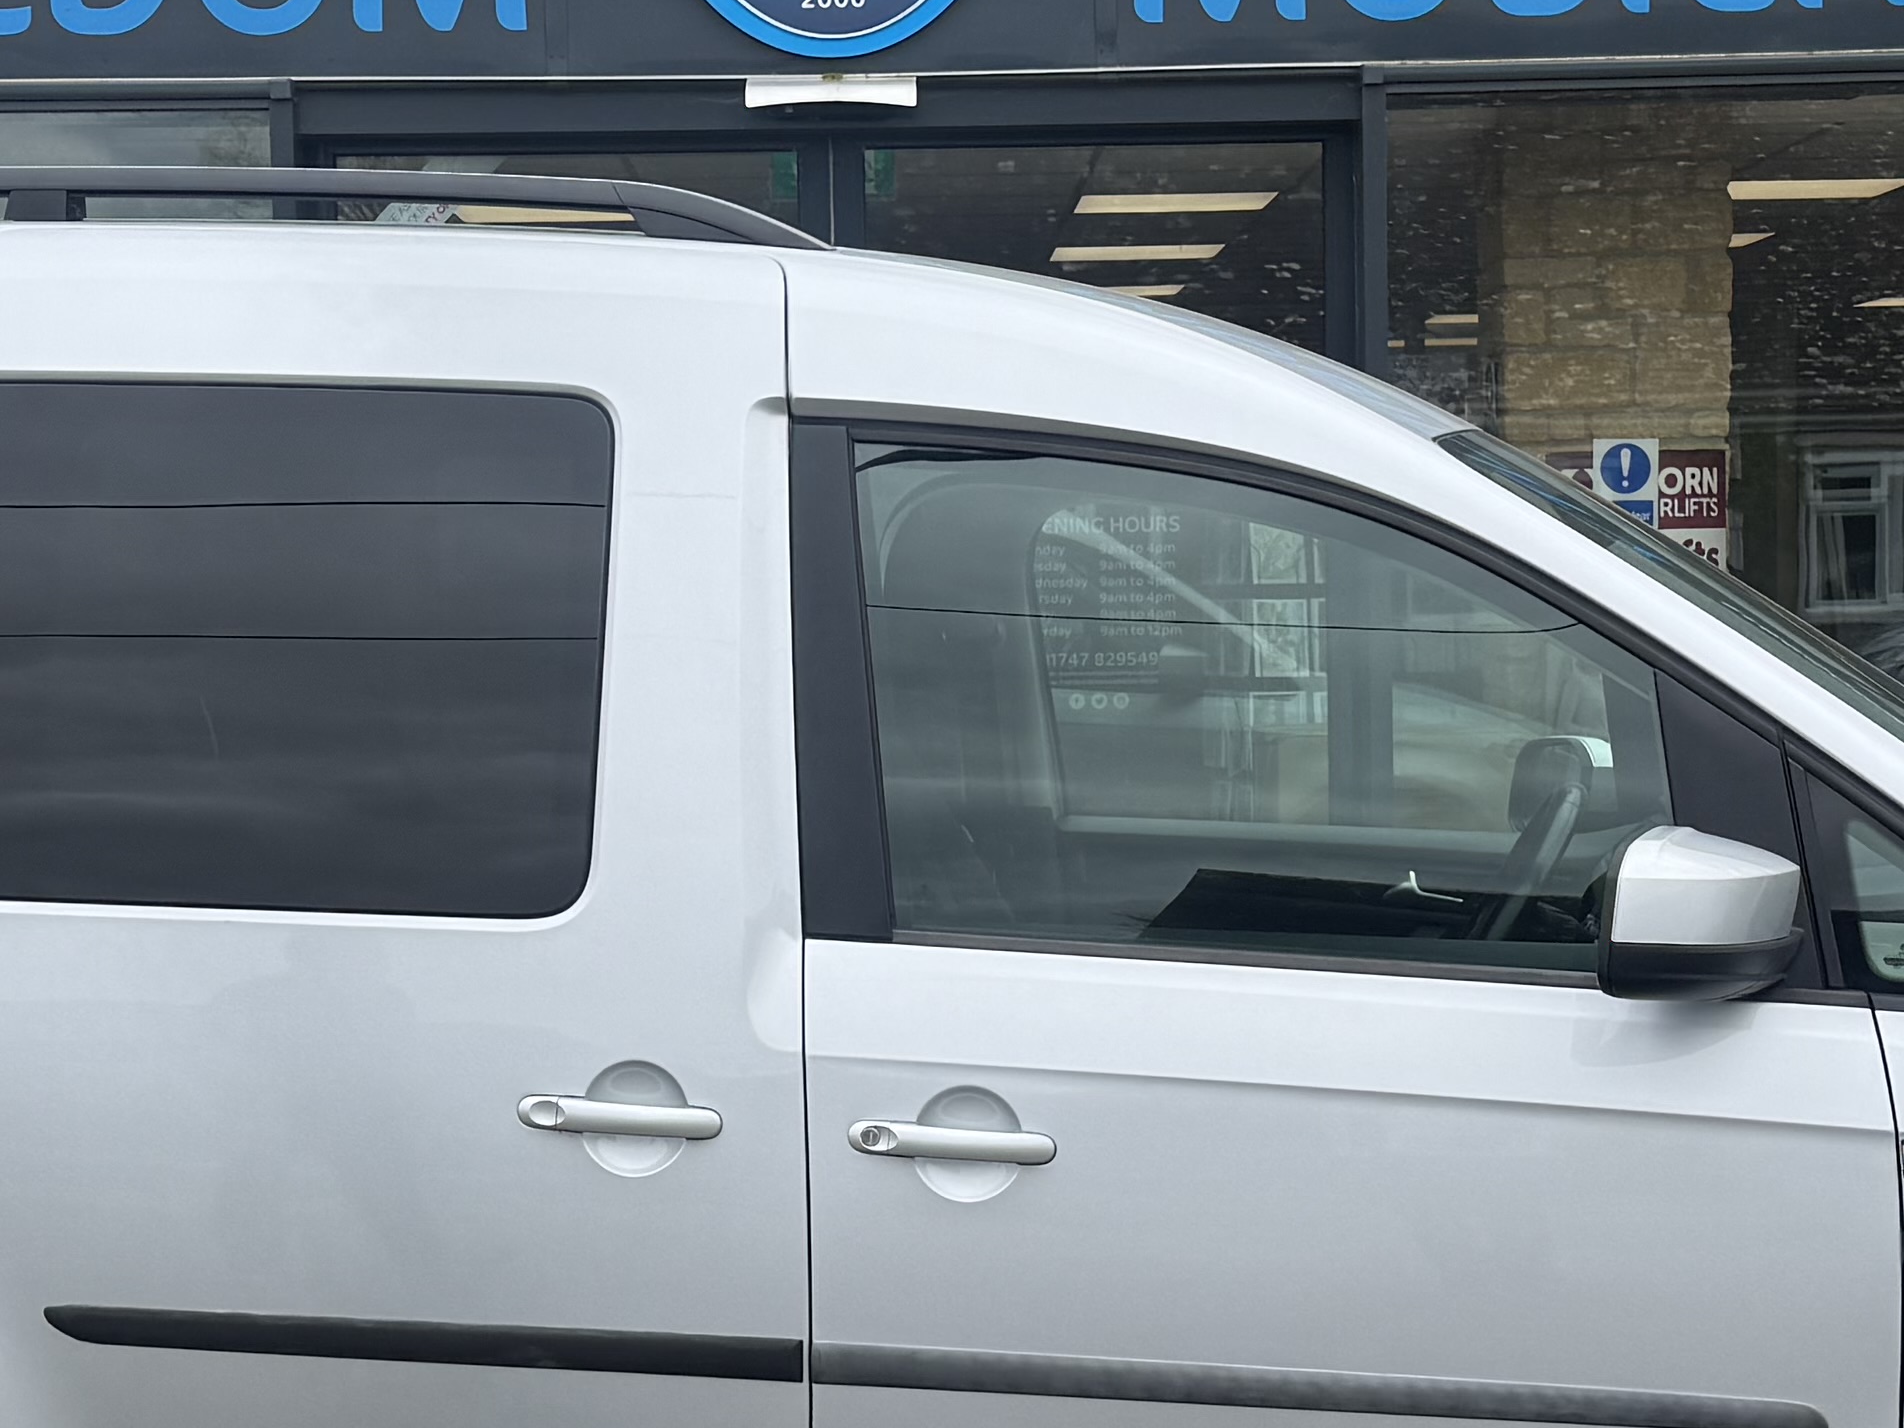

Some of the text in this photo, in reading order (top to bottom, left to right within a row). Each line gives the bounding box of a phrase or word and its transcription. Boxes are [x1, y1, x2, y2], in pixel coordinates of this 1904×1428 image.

[1042, 515, 1181, 534] ENING HOURS
[1035, 545, 1066, 558] nday
[1035, 577, 1088, 590] dnesday
[1130, 576, 1144, 588] to
[1039, 591, 1176, 606] rsday 9am to 4pm
